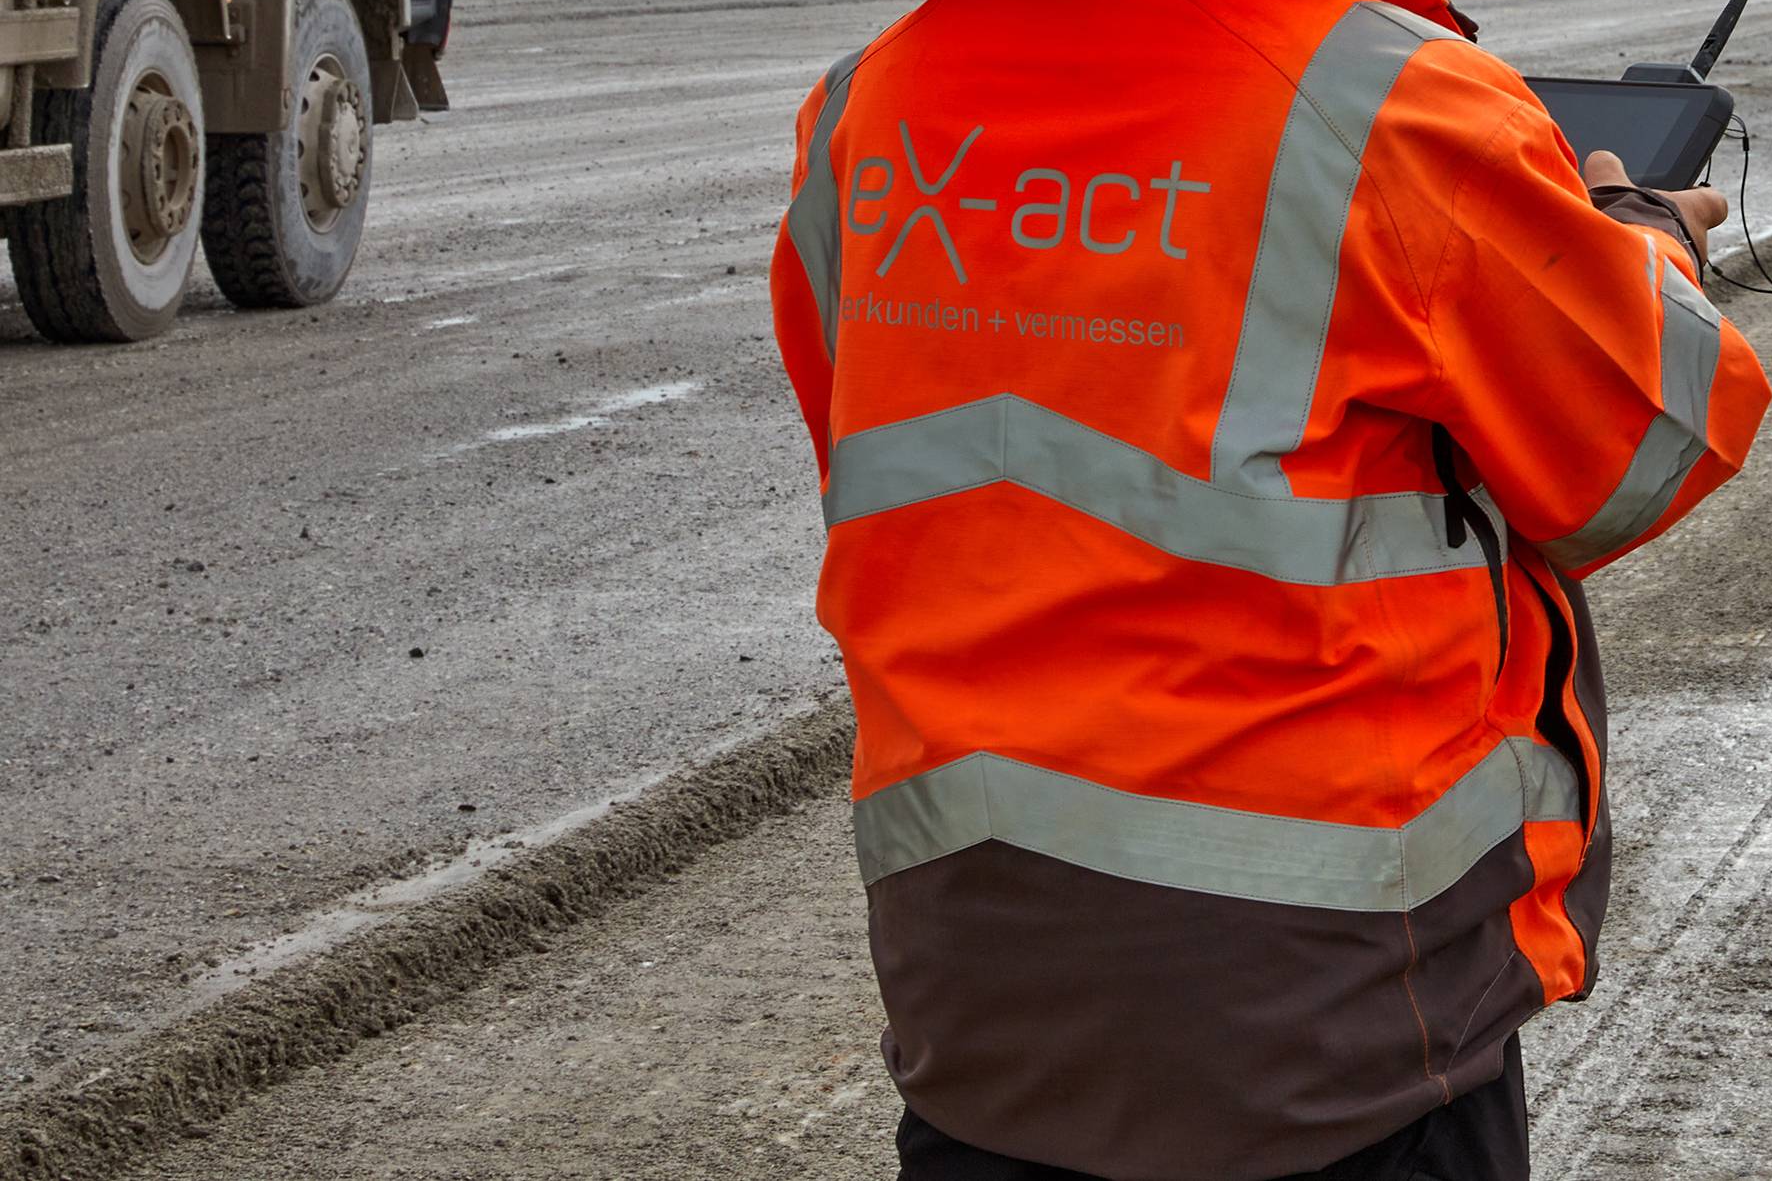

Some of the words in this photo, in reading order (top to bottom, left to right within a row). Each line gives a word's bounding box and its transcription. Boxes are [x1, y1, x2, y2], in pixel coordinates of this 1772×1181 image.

[841, 291, 980, 332] erkunden
[987, 311, 1007, 334] +
[1015, 310, 1184, 348] vermessen
